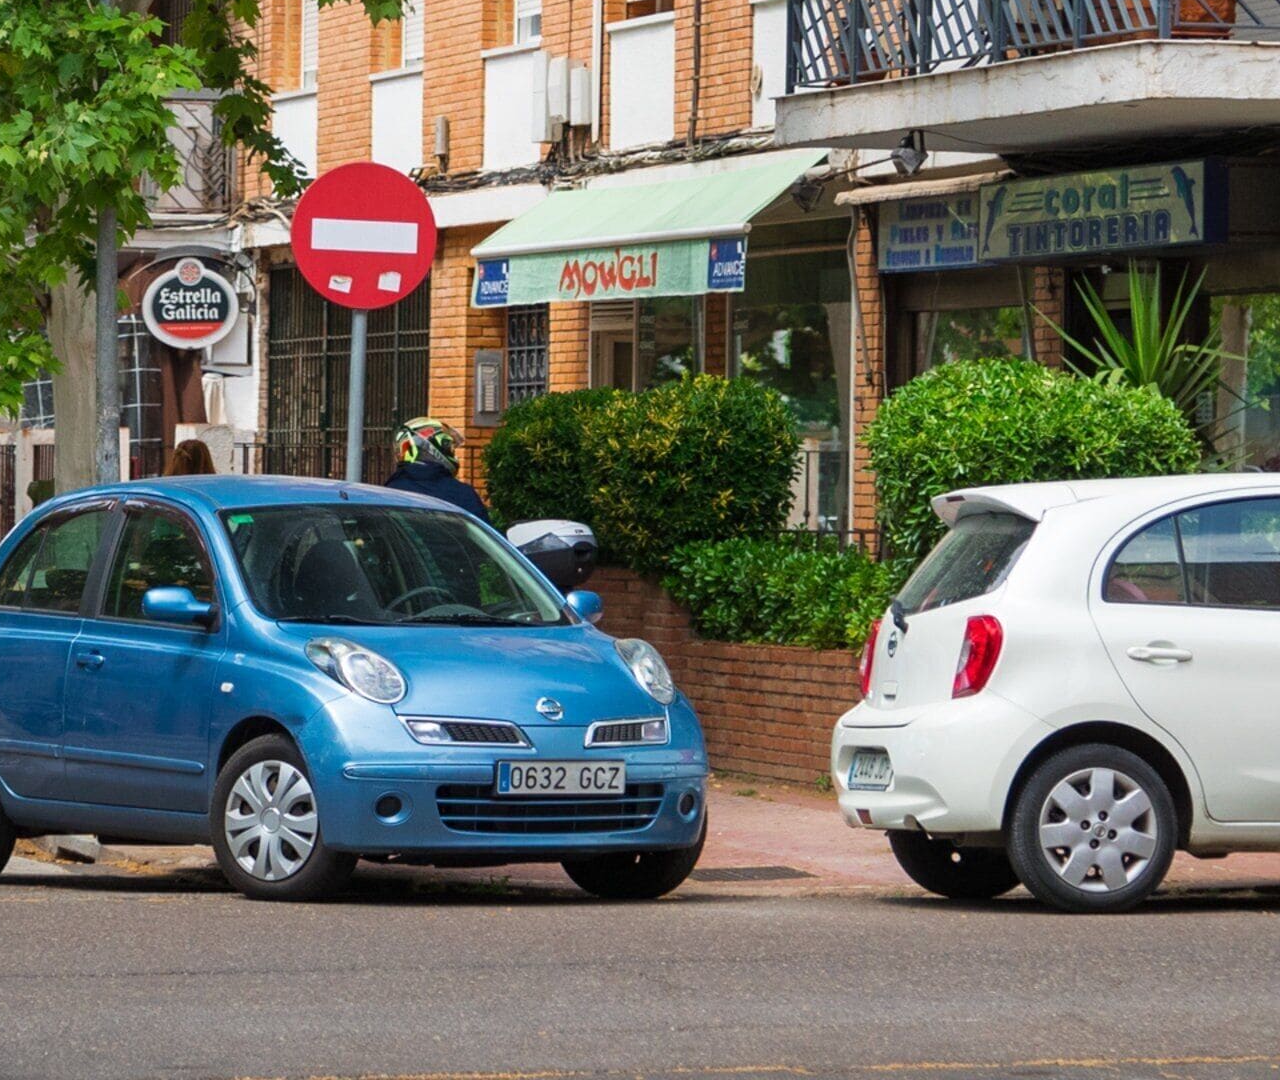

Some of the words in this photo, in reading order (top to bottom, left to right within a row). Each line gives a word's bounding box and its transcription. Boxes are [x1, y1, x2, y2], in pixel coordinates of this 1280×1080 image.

[1044, 173, 1129, 217] coral
[1006, 208, 1172, 256] TINTORERIA
[559, 247, 658, 299] MOWGLI
[713, 260, 745, 277] ADVANCE
[159, 287, 221, 304] Estrella
[162, 303, 219, 321] Galicia
[510, 766, 567, 790] 0632
[580, 767, 620, 790] GCZ
